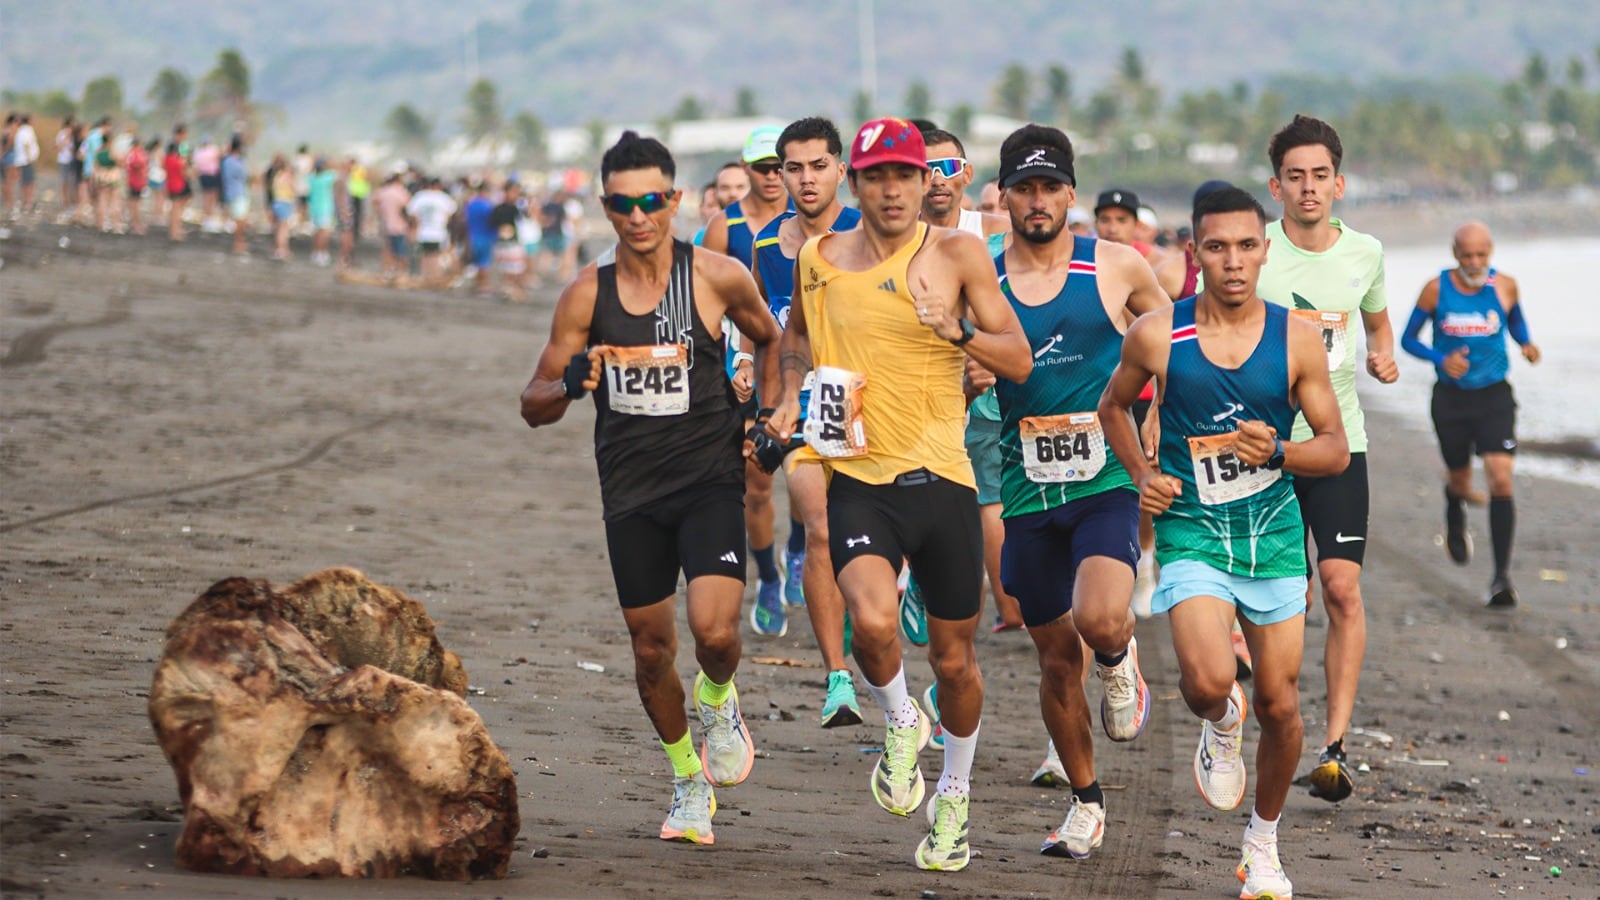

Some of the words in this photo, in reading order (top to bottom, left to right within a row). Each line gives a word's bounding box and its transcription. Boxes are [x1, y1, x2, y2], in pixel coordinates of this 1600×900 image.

[1047, 353, 1084, 366] Runners
[611, 365, 684, 395] 1242
[819, 382, 848, 442] 224
[1196, 421, 1225, 431] Guana
[1035, 432, 1091, 463] 664
[1199, 453, 1270, 485] 154
